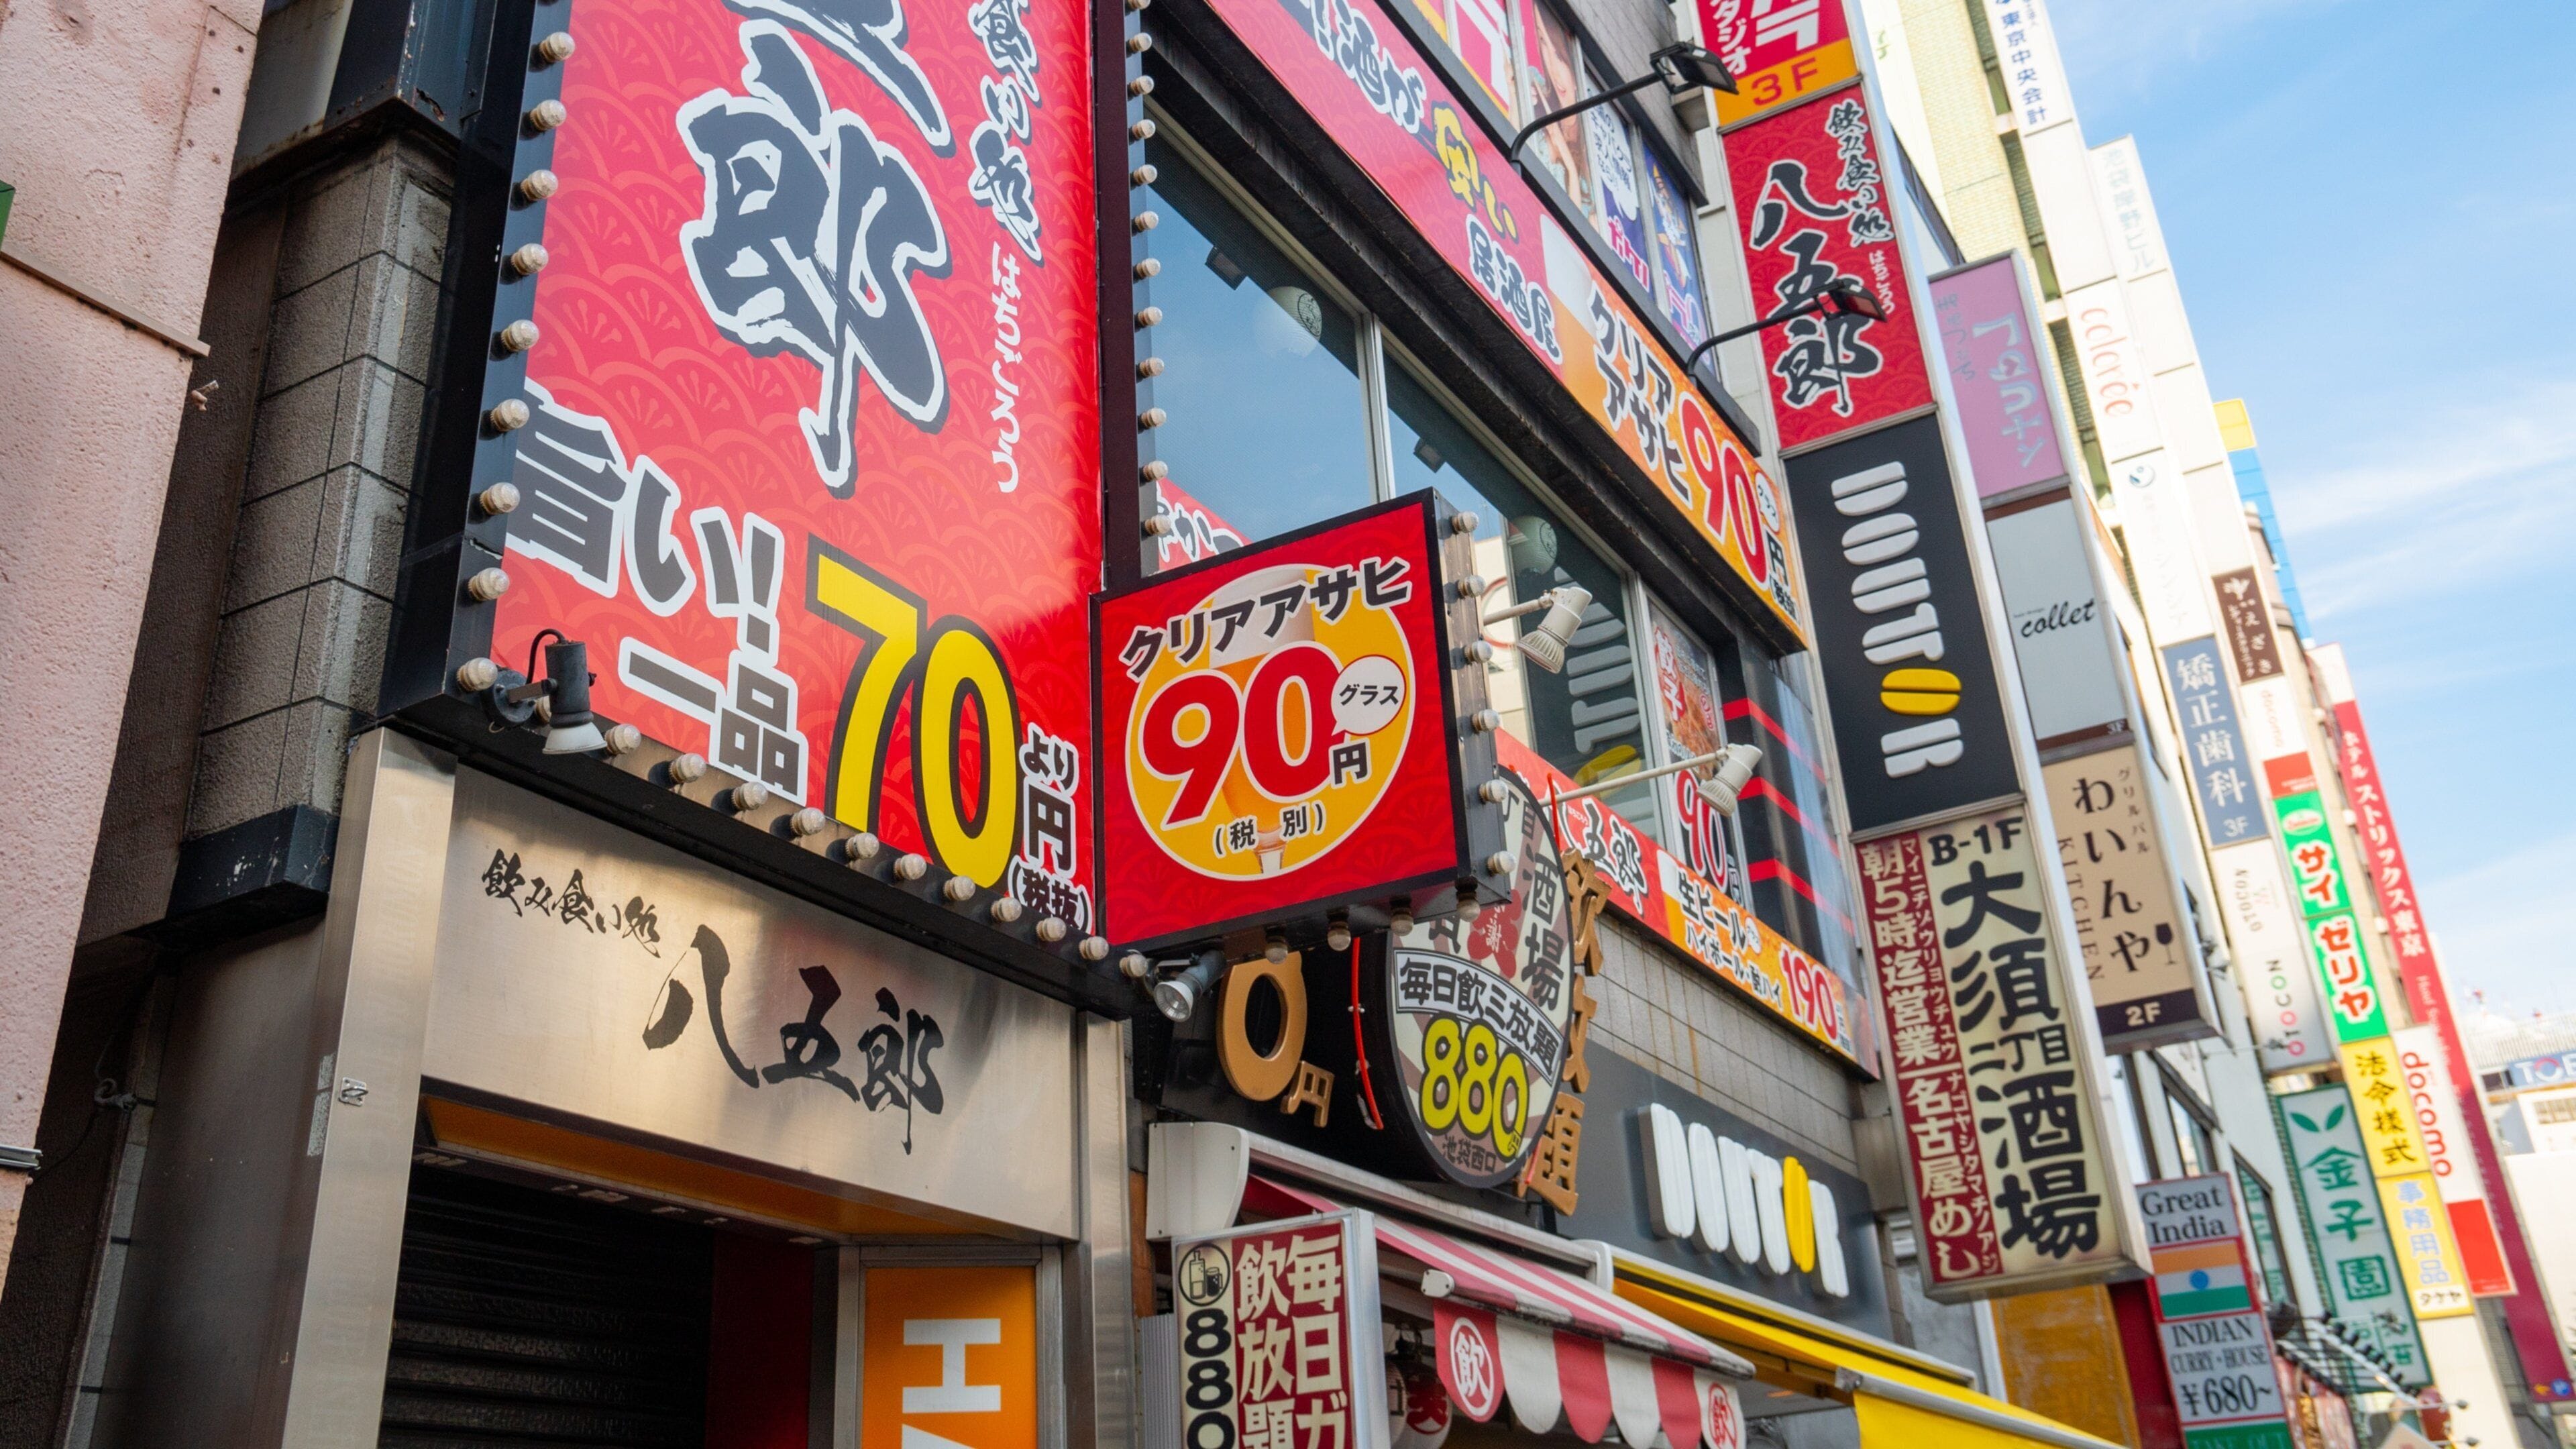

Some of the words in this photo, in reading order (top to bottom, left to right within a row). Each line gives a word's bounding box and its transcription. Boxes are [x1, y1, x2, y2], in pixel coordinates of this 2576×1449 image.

[1751, 57, 1818, 107] 3F
[1465, 213, 1564, 365] 居酒屋
[991, 241, 1020, 494] はちごろう
[1587, 282, 1676, 420] クリア
[1593, 343, 1693, 510] アサヒ
[1678, 391, 1770, 592] 90
[1119, 555, 1411, 680] クリアアサヒ
[1830, 460, 1965, 779] DOUTOR
[2021, 598, 2095, 638] collet
[619, 636, 808, 806] 一品
[805, 533, 1024, 890] 70
[1138, 640, 1346, 831] 90
[1338, 682, 1400, 707] グラス
[2176, 651, 2248, 808] 矯正歯科
[1019, 722, 1079, 791] より
[1330, 741, 1369, 787] 円
[2118, 766, 2149, 855] グリルバル
[1023, 780, 1077, 879] 円
[1927, 816, 2025, 867] B-1F
[2072, 777, 2152, 974] わいんや
[2222, 816, 2249, 839] 3F
[481, 847, 661, 959] 飲み食い処
[1676, 867, 1748, 954] 生ビール
[2057, 837, 2106, 981] KITCHEN
[2294, 842, 2373, 1021] サイゼリヤ
[641, 924, 945, 1156] 八五郎
[1778, 942, 1839, 1040] 190
[2125, 1002, 2161, 1026] 2F
[1419, 1013, 1529, 1163] 880
[2402, 1052, 2453, 1178] docomo
[1442, 1132, 1497, 1174] 池袋西口
[1905, 1076, 1982, 1280] 名古屋めし
[2141, 1185, 2224, 1216] Great
[2150, 1216, 2226, 1244] India
[2394, 1179, 2451, 1285] 事務用品
[1453, 1332, 1492, 1398] 飲
[2172, 1317, 2254, 1348] INDIAN
[1710, 1389, 1737, 1444] 飲
